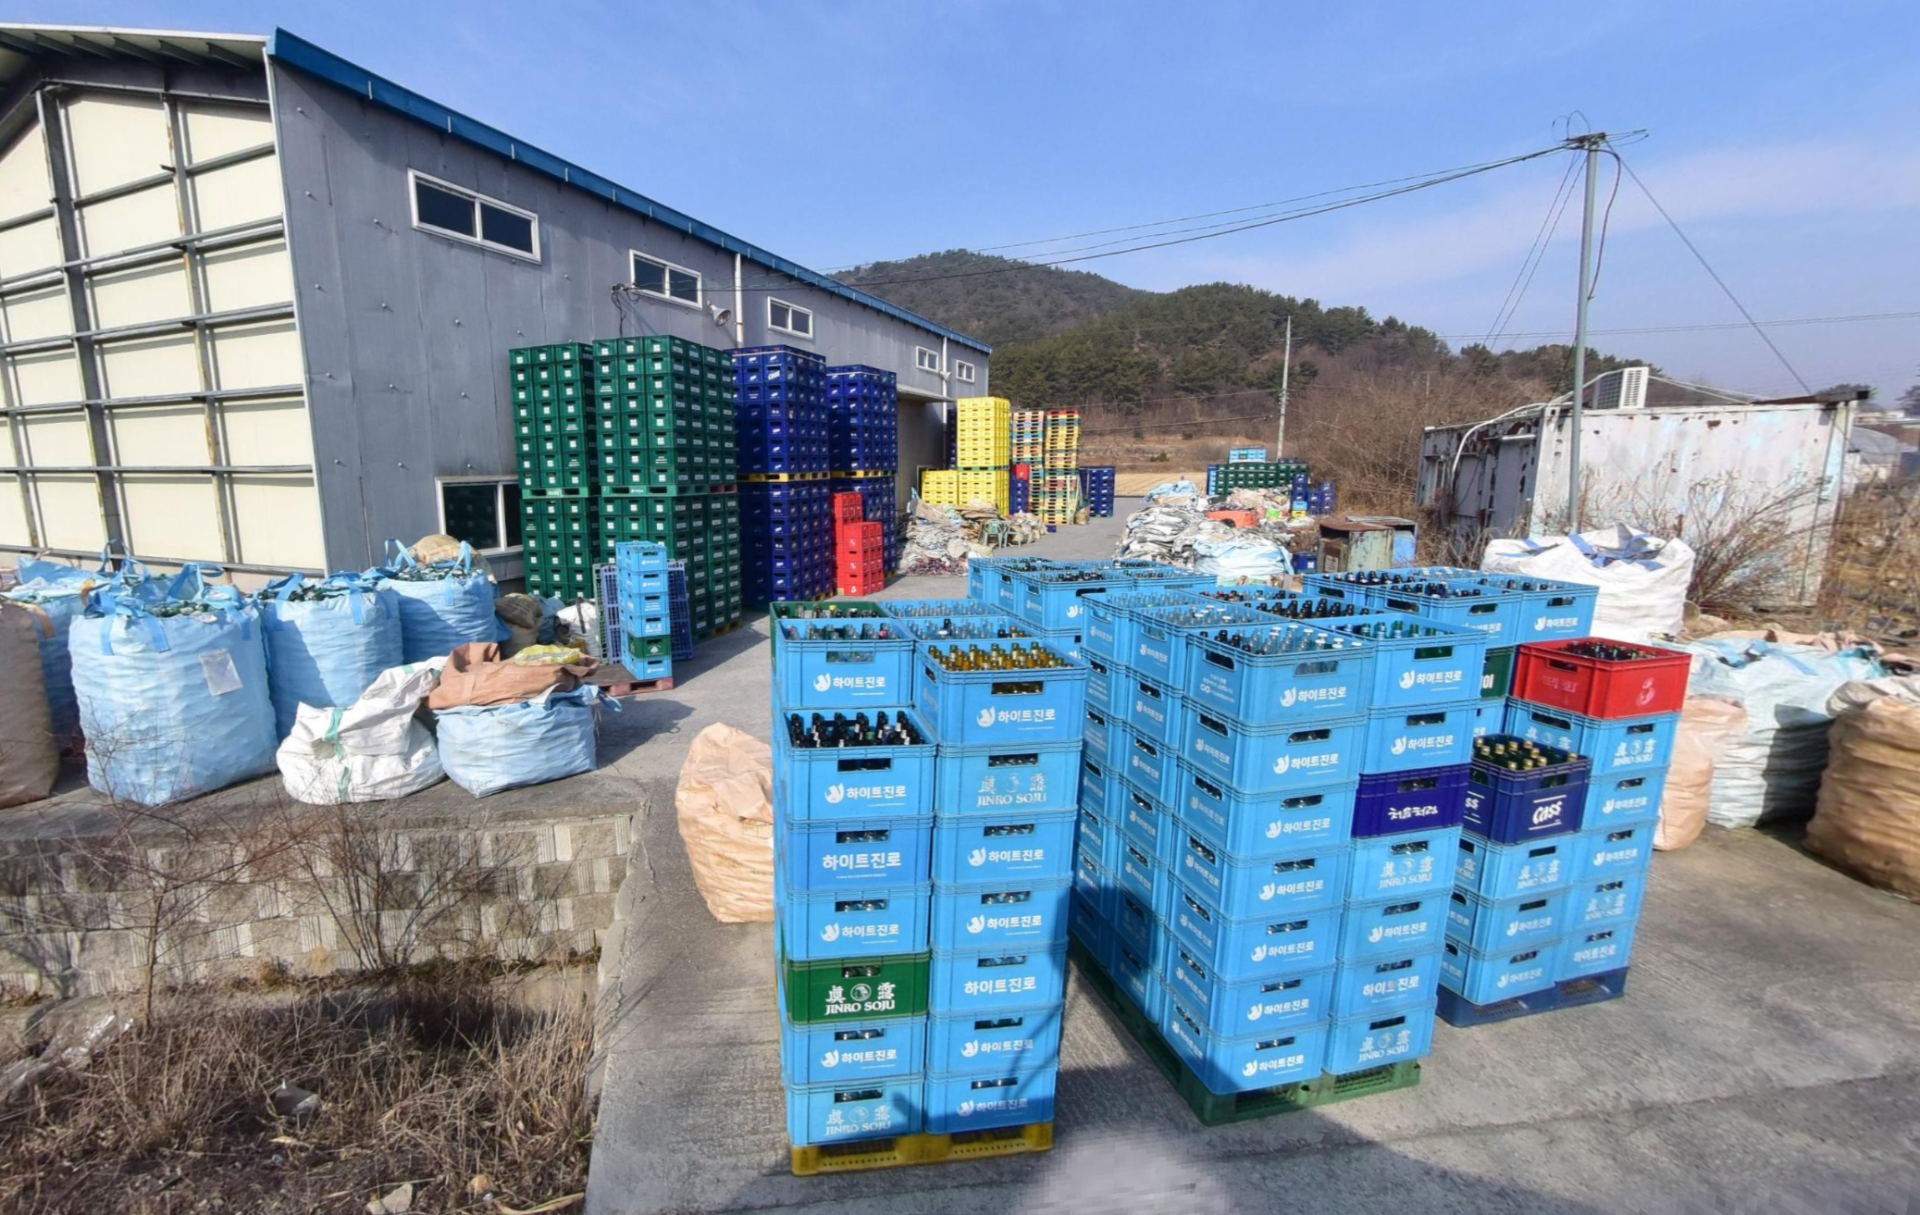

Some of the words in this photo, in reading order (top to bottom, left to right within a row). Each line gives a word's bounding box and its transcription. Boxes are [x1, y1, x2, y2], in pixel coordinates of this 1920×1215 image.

[832, 676, 886, 690] 하이트진로
[1415, 670, 1462, 685] 하이트진로
[1297, 687, 1347, 703] 하이트진로
[997, 709, 1056, 723] 하이트진로
[1407, 735, 1454, 750] 하이트진로
[1290, 754, 1339, 769] 하이트진로
[846, 785, 907, 799] 하이트진로
[976, 792, 1013, 807] JINRO
[1015, 792, 1048, 805] SOJU
[1387, 805, 1438, 820] 처음처럼
[1283, 818, 1331, 834] 하이트진로
[822, 851, 901, 870] 하이트진로
[988, 848, 1044, 862] 하이트진로
[1276, 880, 1324, 895] 하이트진로
[1379, 877, 1406, 889] JINRO
[1408, 873, 1432, 884] SOJU
[986, 915, 1042, 929] 하이트진로
[841, 924, 900, 938] 하이트진로
[1384, 922, 1428, 938] 하이트진로
[1268, 941, 1315, 957] 하이트진로
[963, 976, 1037, 995] 하이트진로
[1362, 975, 1420, 996] 하이트진로
[824, 1001, 861, 1016] JINRO
[863, 999, 896, 1012] SOJU
[1264, 998, 1309, 1015] 하이트진로
[980, 1039, 1034, 1053] 하이트진로
[1358, 1048, 1385, 1063] JINRO
[1386, 1043, 1409, 1057] SOJU
[841, 1049, 897, 1063] 하이트진로
[1259, 1055, 1304, 1072] 하이트진로
[975, 1098, 1027, 1113] 하이트진로
[825, 1123, 859, 1137] JINRO
[861, 1120, 892, 1133] SOJU
